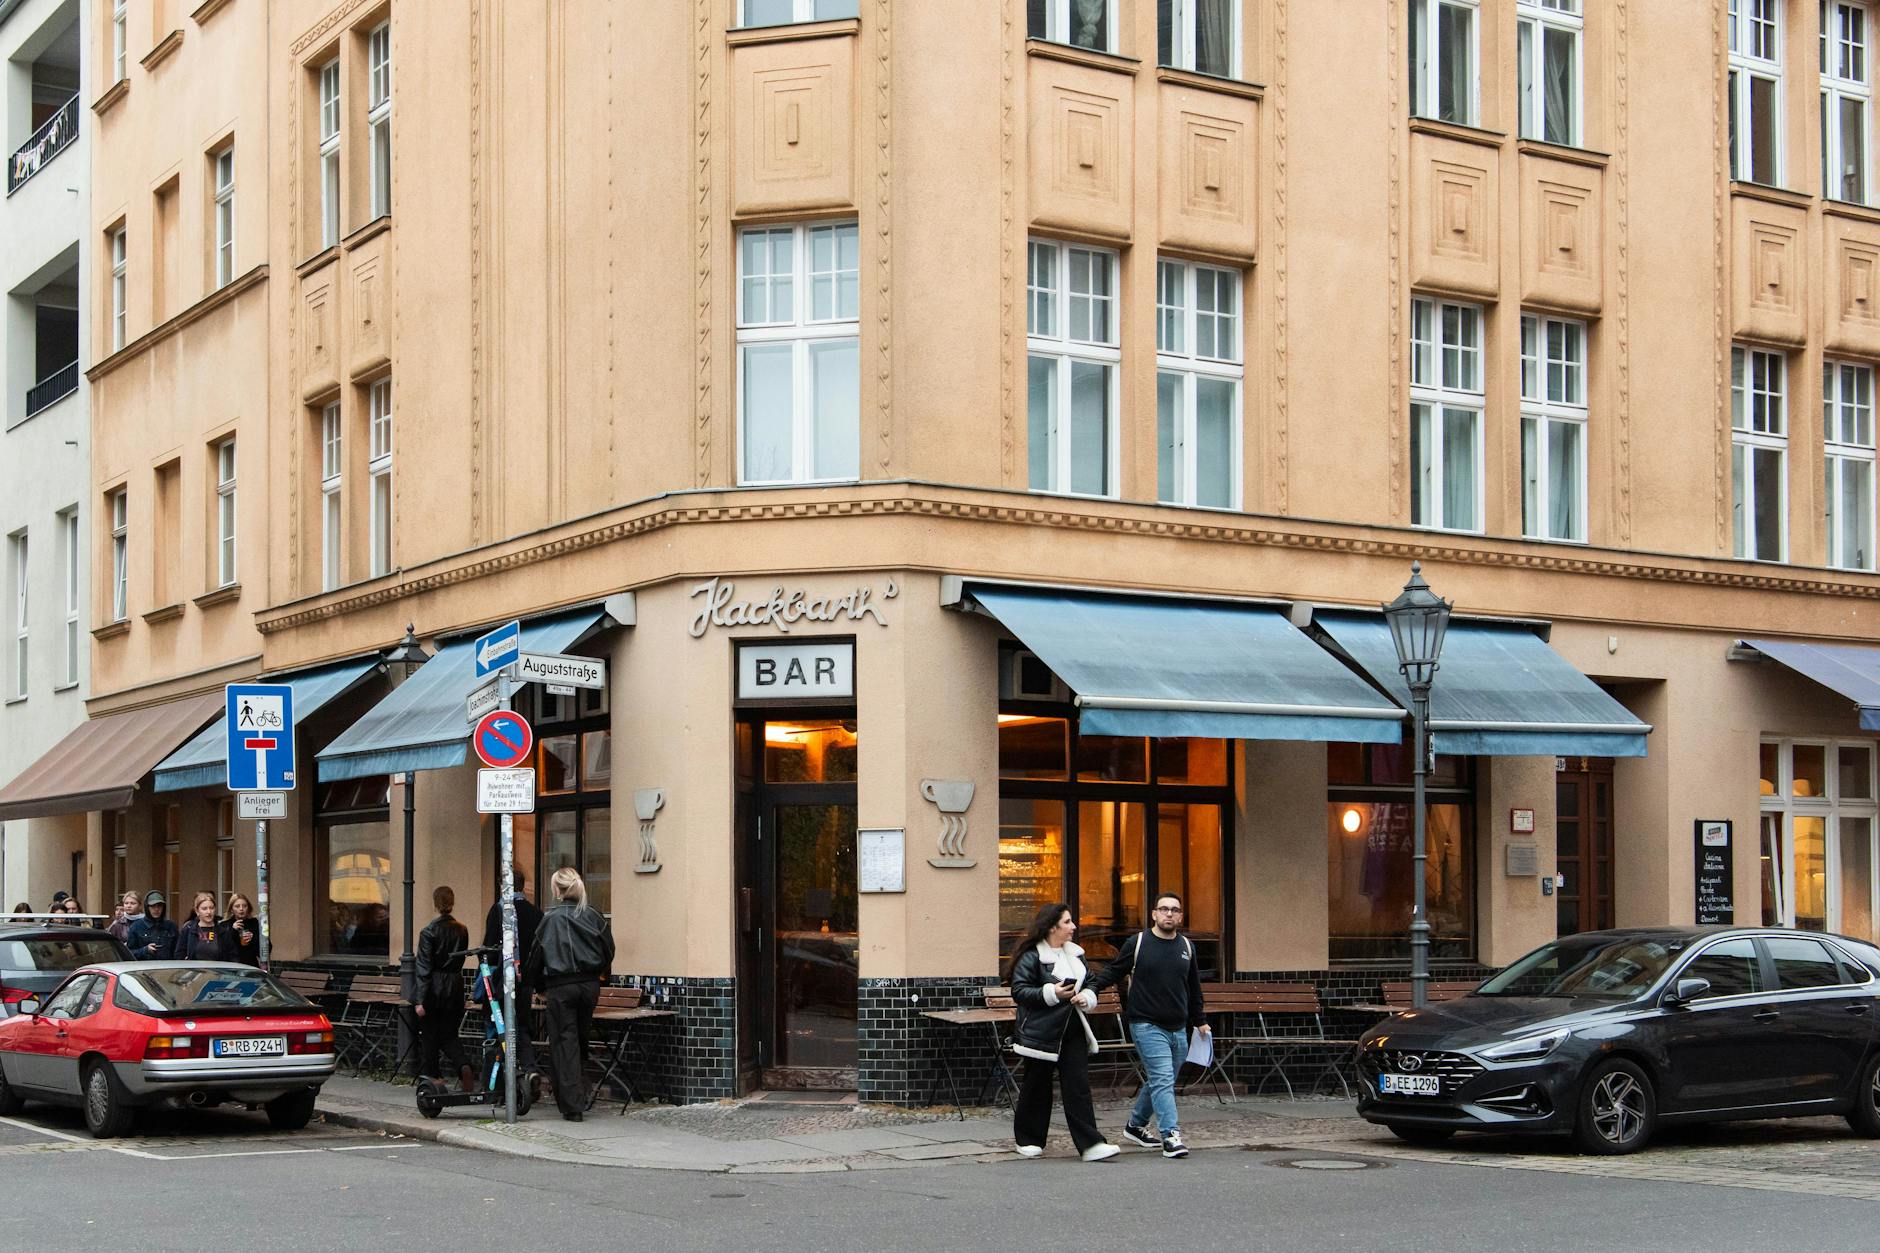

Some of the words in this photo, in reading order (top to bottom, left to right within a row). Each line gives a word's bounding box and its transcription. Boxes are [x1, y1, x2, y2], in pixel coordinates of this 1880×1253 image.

[523, 658, 598, 681] Auguststraße
[755, 657, 836, 686] BAR
[495, 773, 511, 781] 9-24
[244, 796, 280, 806] Anlieger
[255, 806, 270, 814] frei
[221, 1041, 229, 1053] B
[235, 1040, 251, 1052] RB
[1385, 1076, 1391, 1089] B
[1397, 1076, 1410, 1090] EE
[1413, 1077, 1438, 1091] 1296
